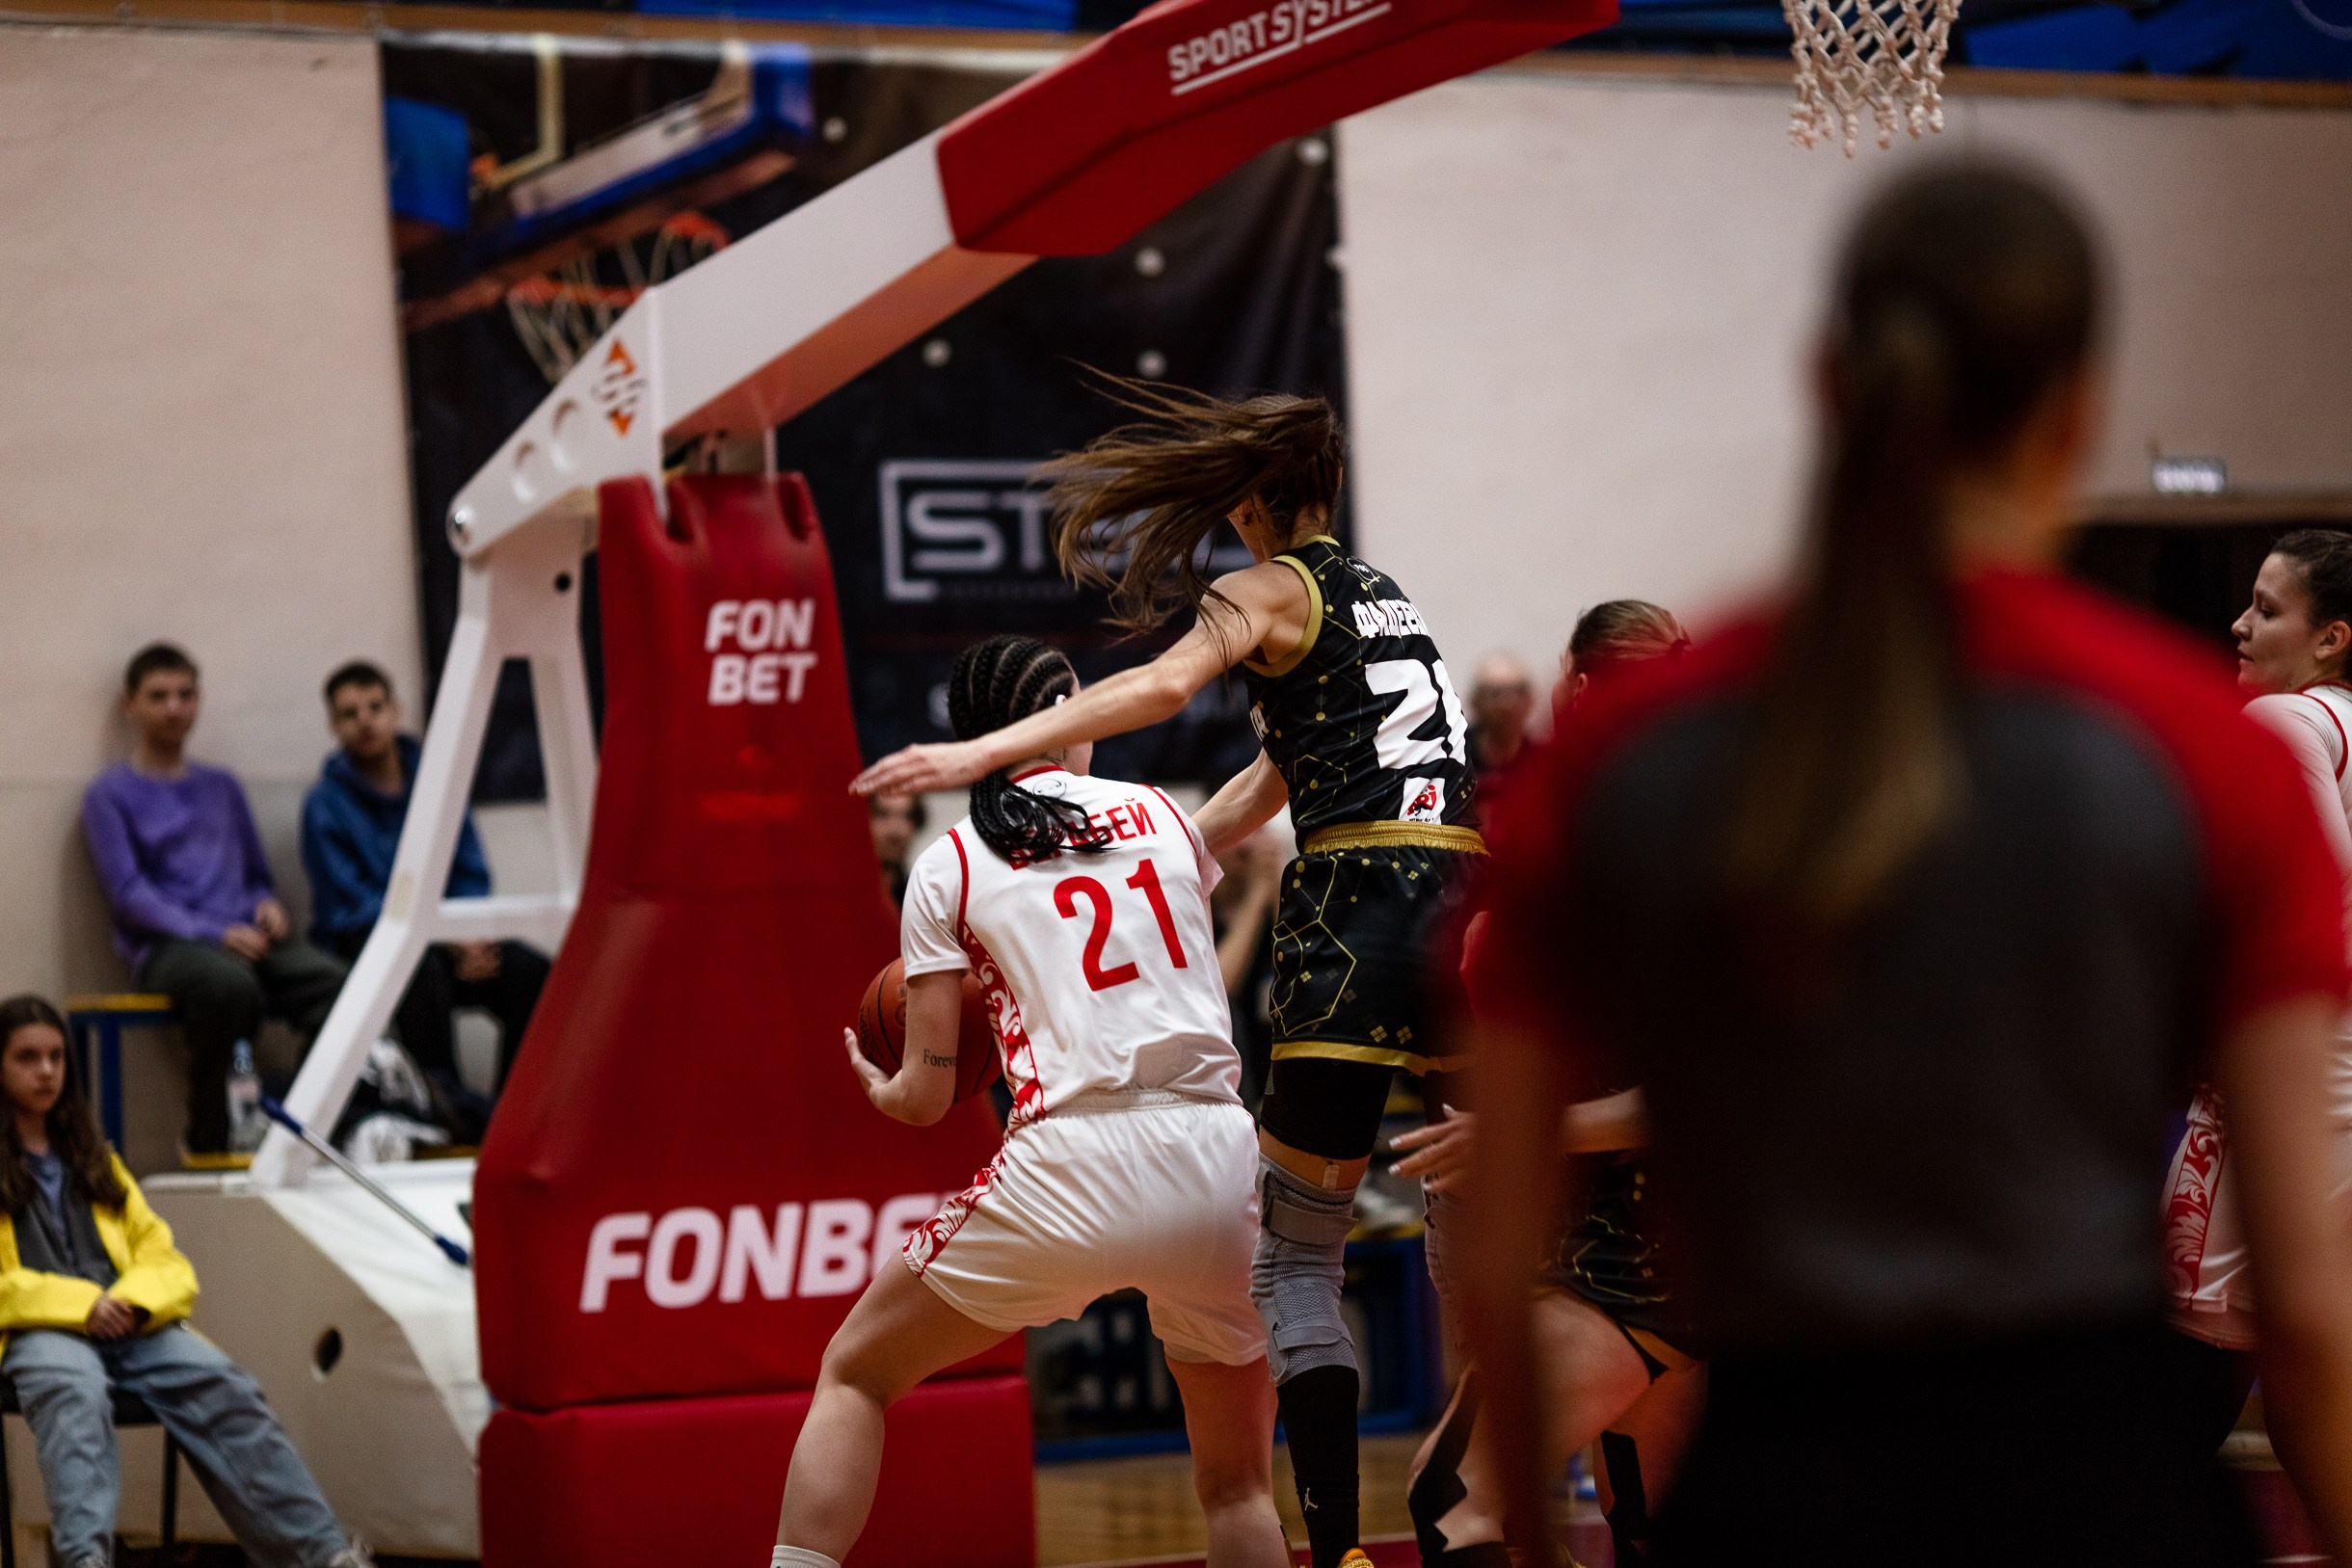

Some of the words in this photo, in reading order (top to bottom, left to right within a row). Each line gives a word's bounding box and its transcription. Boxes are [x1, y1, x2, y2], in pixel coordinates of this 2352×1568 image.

[705, 598, 815, 651] FON
[707, 651, 818, 705] BET
[1053, 858, 1189, 992] 21
[579, 1192, 976, 1314] FONBE
